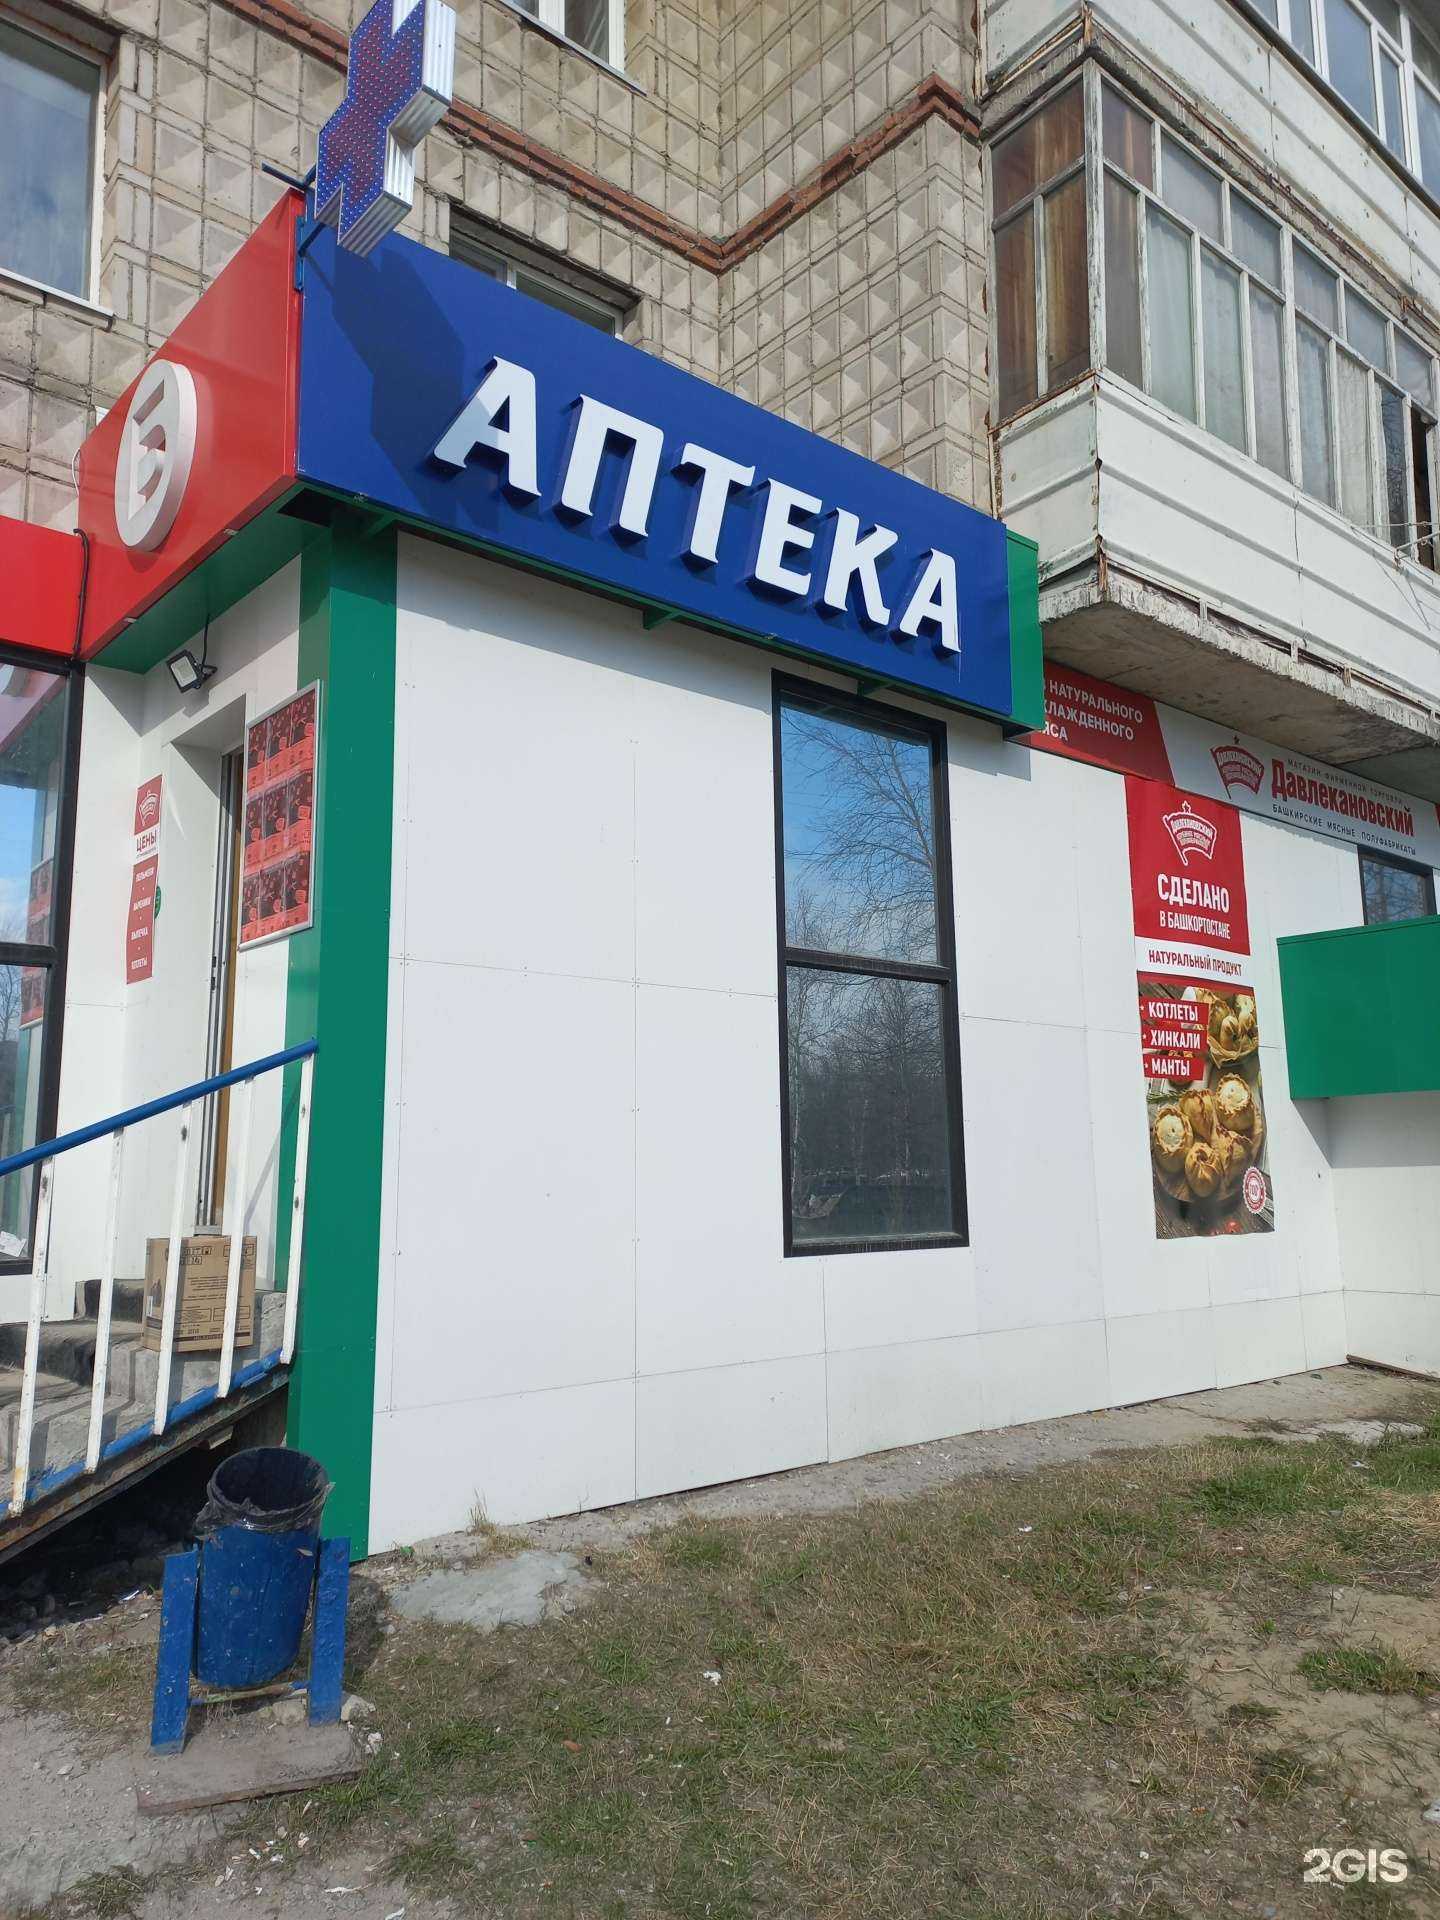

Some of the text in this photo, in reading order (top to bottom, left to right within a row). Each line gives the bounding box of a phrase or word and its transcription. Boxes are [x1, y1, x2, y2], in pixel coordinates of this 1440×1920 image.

[434, 356, 961, 653] АПТЕКА
[1049, 680, 1143, 723] НАТУРАЛЬНОГО
[1271, 758, 1416, 837] Давлекановский
[136, 829, 157, 852] ЦЕНЫ
[1272, 803, 1416, 856] БАШКИРСКИЕ МЯСНЫЕ ПОЛУФАБРИКАТЫ
[1157, 873, 1230, 914] СДЕЛАНО
[1159, 910, 1231, 940] В БАШКОРТОСТАНЕ
[1148, 950, 1242, 977] НАТУРАЛЬНЫЙ ПРОДУКТ
[1148, 1001, 1198, 1021] КОТЛЕТЫ
[1150, 1029, 1201, 1050] ХИНКАЛИ
[1151, 1058, 1190, 1076] МАНТЫ
